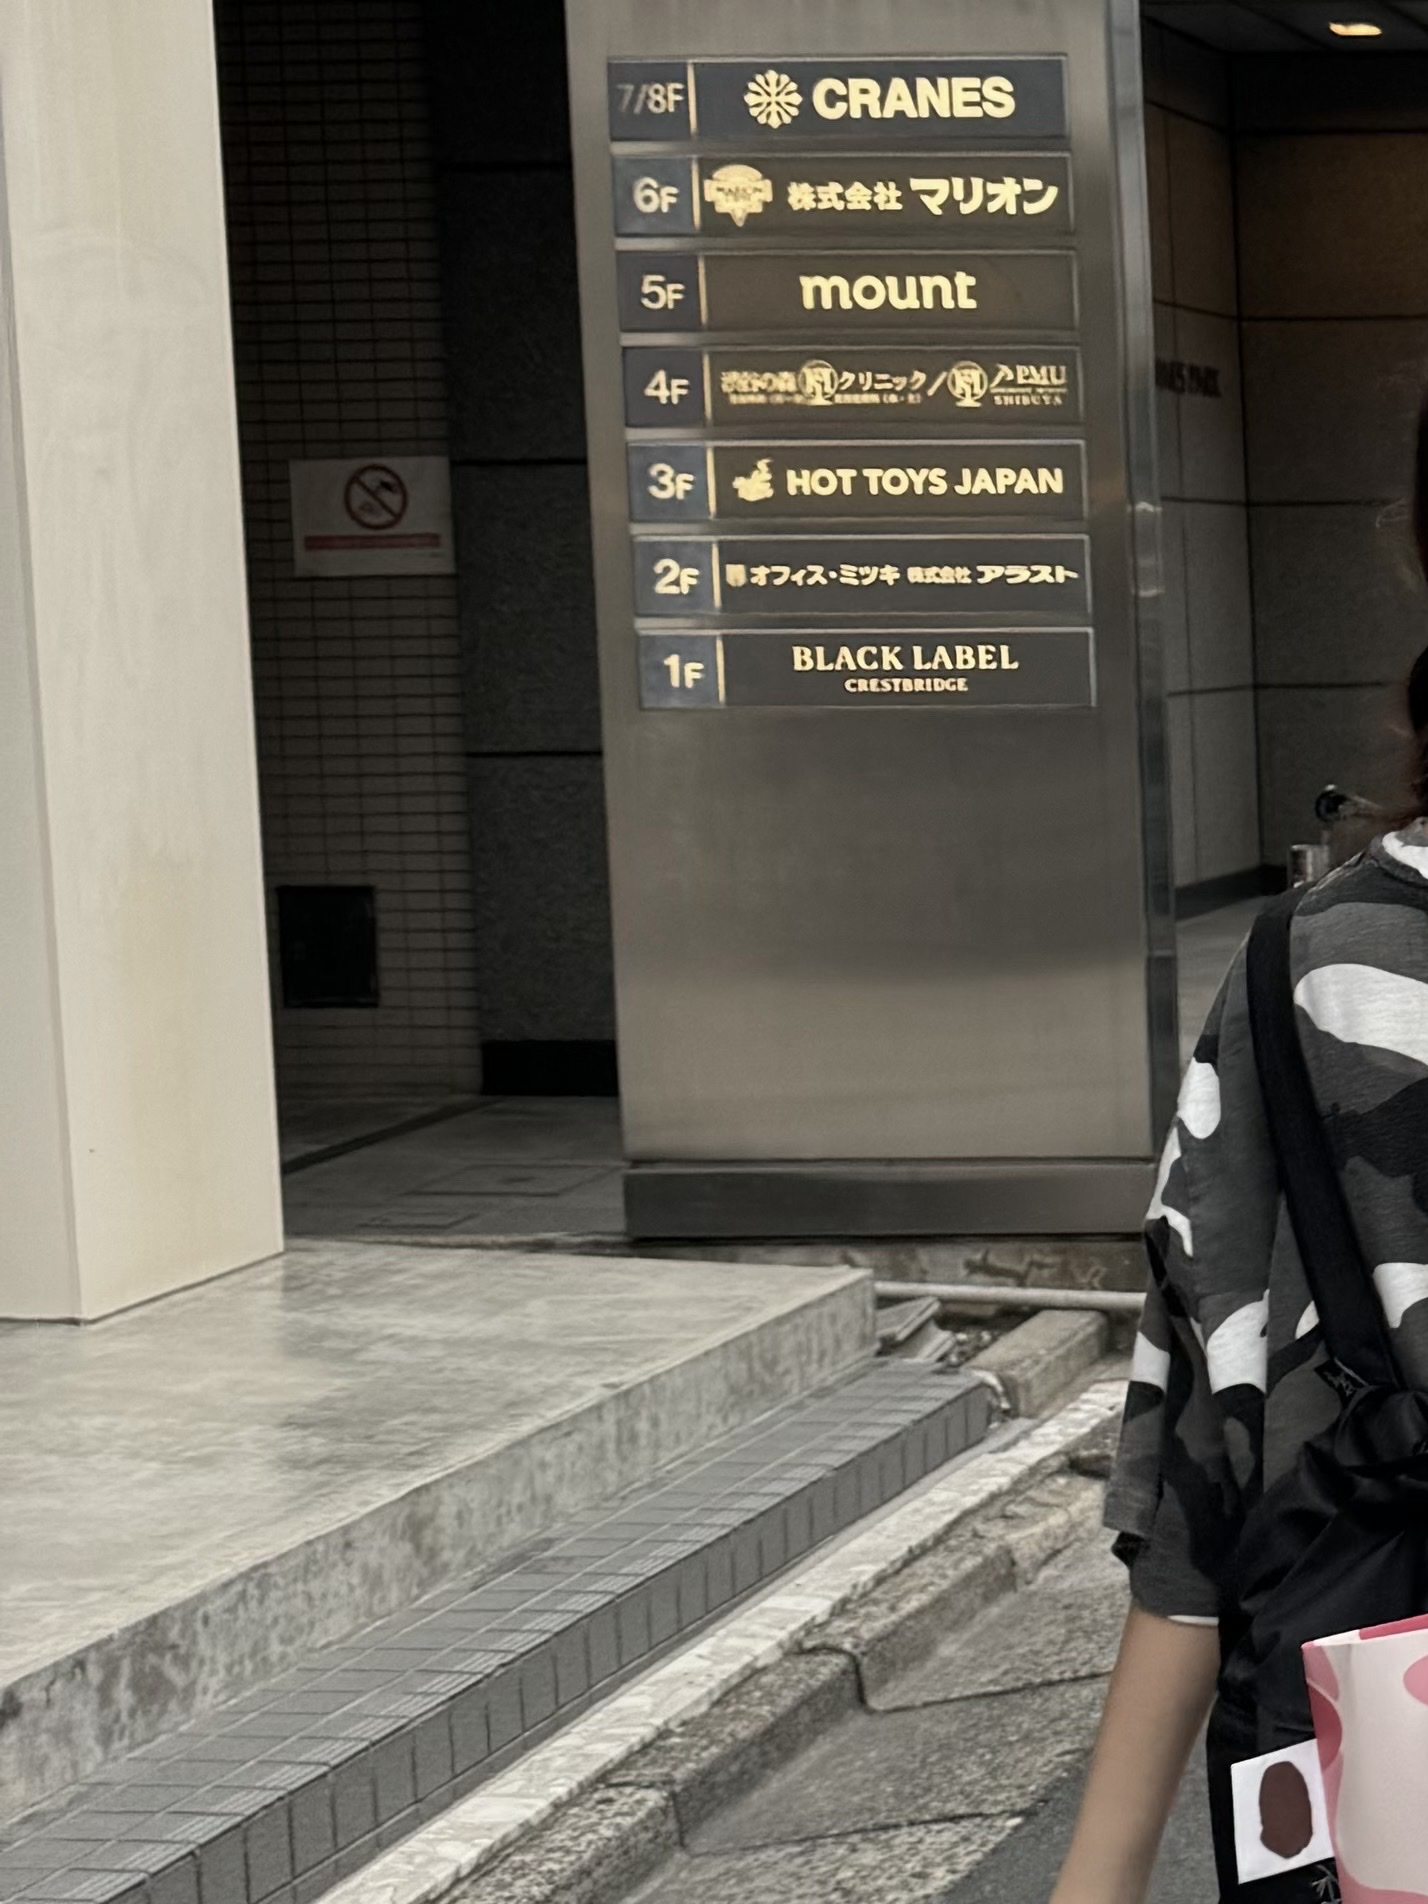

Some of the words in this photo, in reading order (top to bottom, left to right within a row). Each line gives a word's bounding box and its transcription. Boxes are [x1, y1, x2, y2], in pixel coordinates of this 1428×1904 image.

[617, 82, 685, 115] 7/8F
[812, 76, 1017, 121] CRANES
[633, 176, 679, 214] 6F
[787, 181, 904, 212] 株式会社
[910, 177, 1059, 216] マリオン
[641, 275, 686, 310] 5F
[800, 270, 978, 311] mount
[644, 369, 690, 405] 4F
[648, 463, 696, 501] 3F
[786, 468, 859, 497] HOT
[862, 468, 950, 497] TOYS
[954, 468, 1065, 497] JAPAN
[653, 558, 700, 596] 2F
[749, 564, 901, 587] オフィス・ミツキ
[977, 565, 1080, 585] アラスト
[663, 653, 705, 690] 1F
[793, 645, 905, 672] BLACK
[912, 645, 1020, 672] LABEL
[844, 677, 970, 693] CRESTBRIDGE
